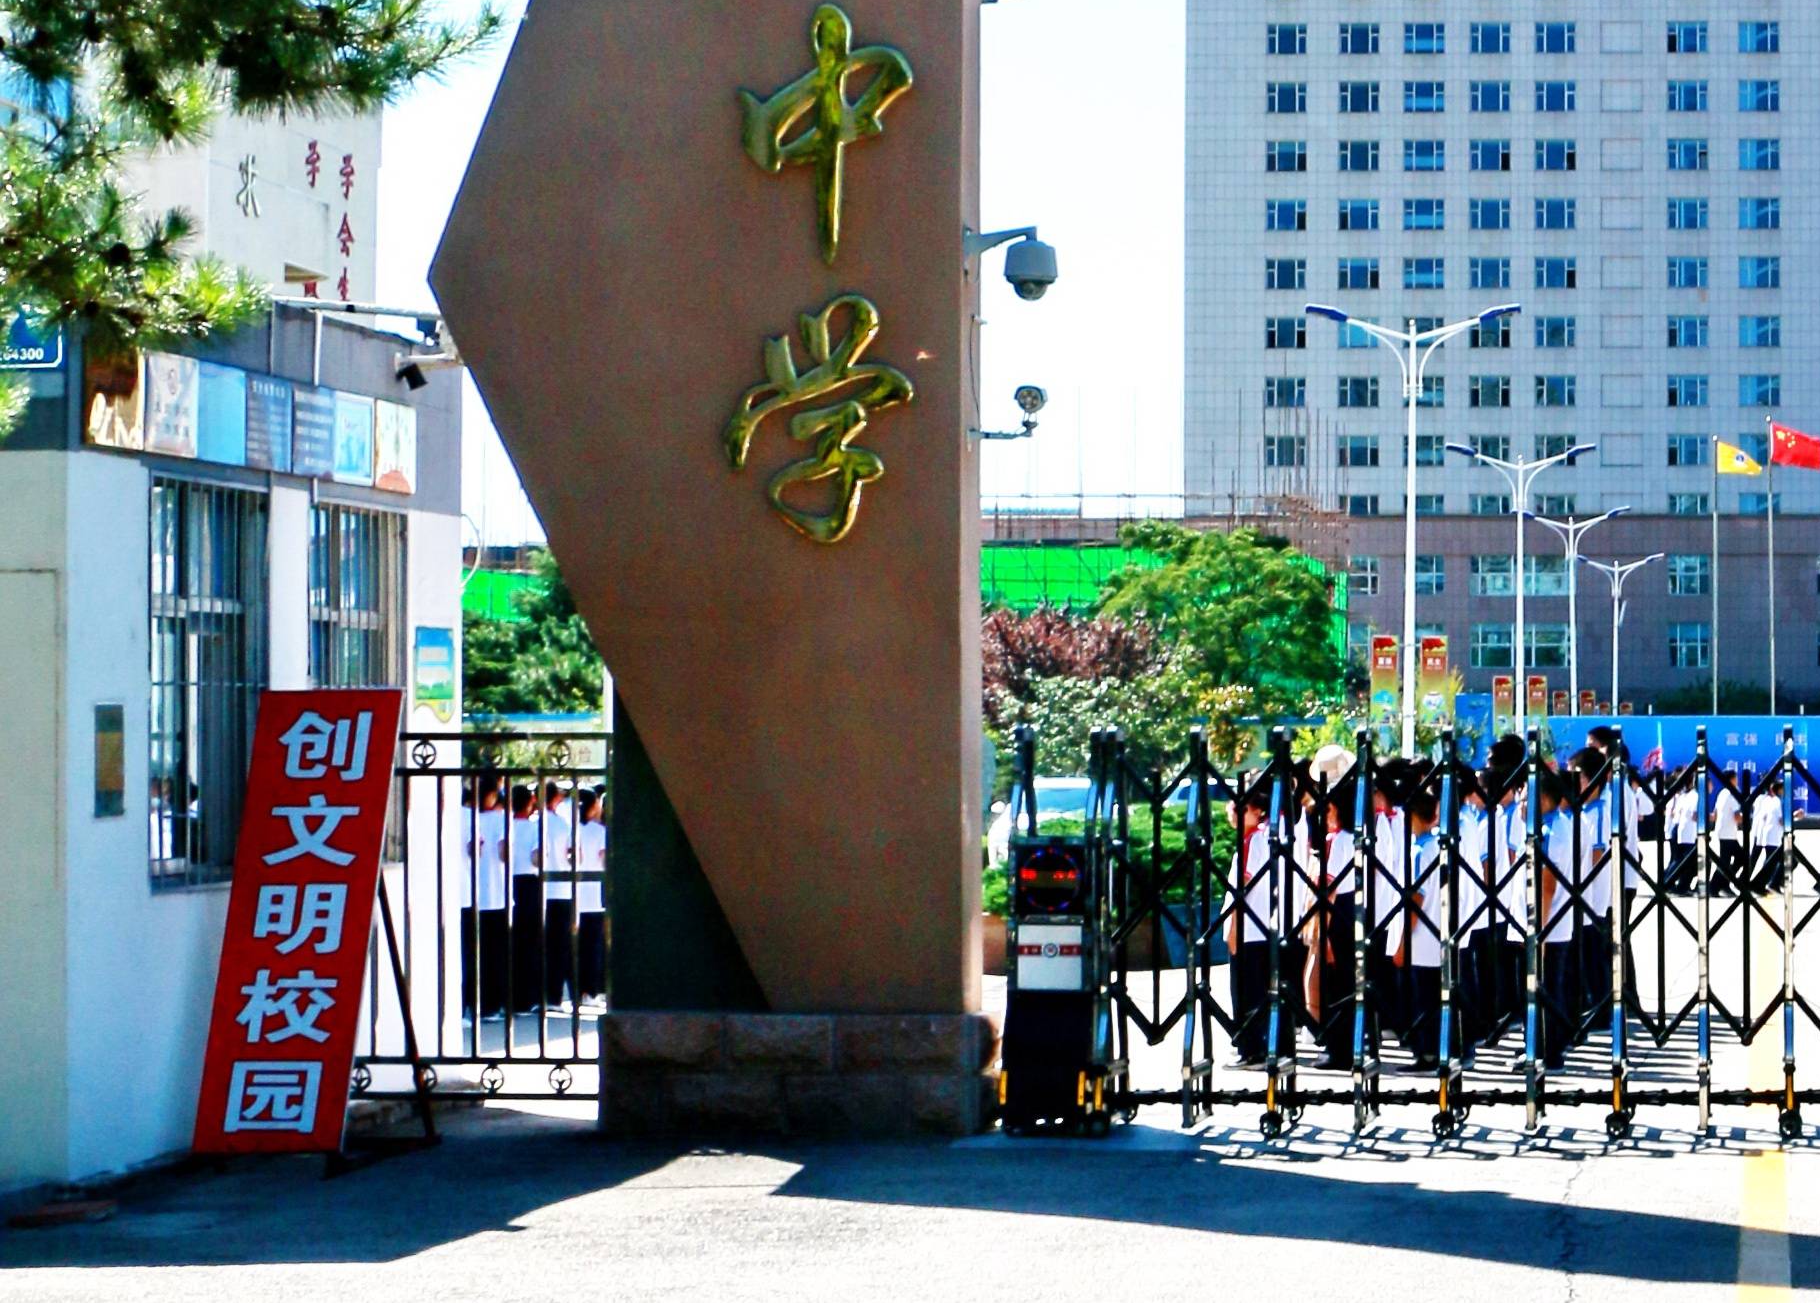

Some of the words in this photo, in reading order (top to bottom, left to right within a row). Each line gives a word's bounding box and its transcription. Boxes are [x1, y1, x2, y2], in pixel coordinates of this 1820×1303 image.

[223, 711, 373, 1134] 创文明校园
